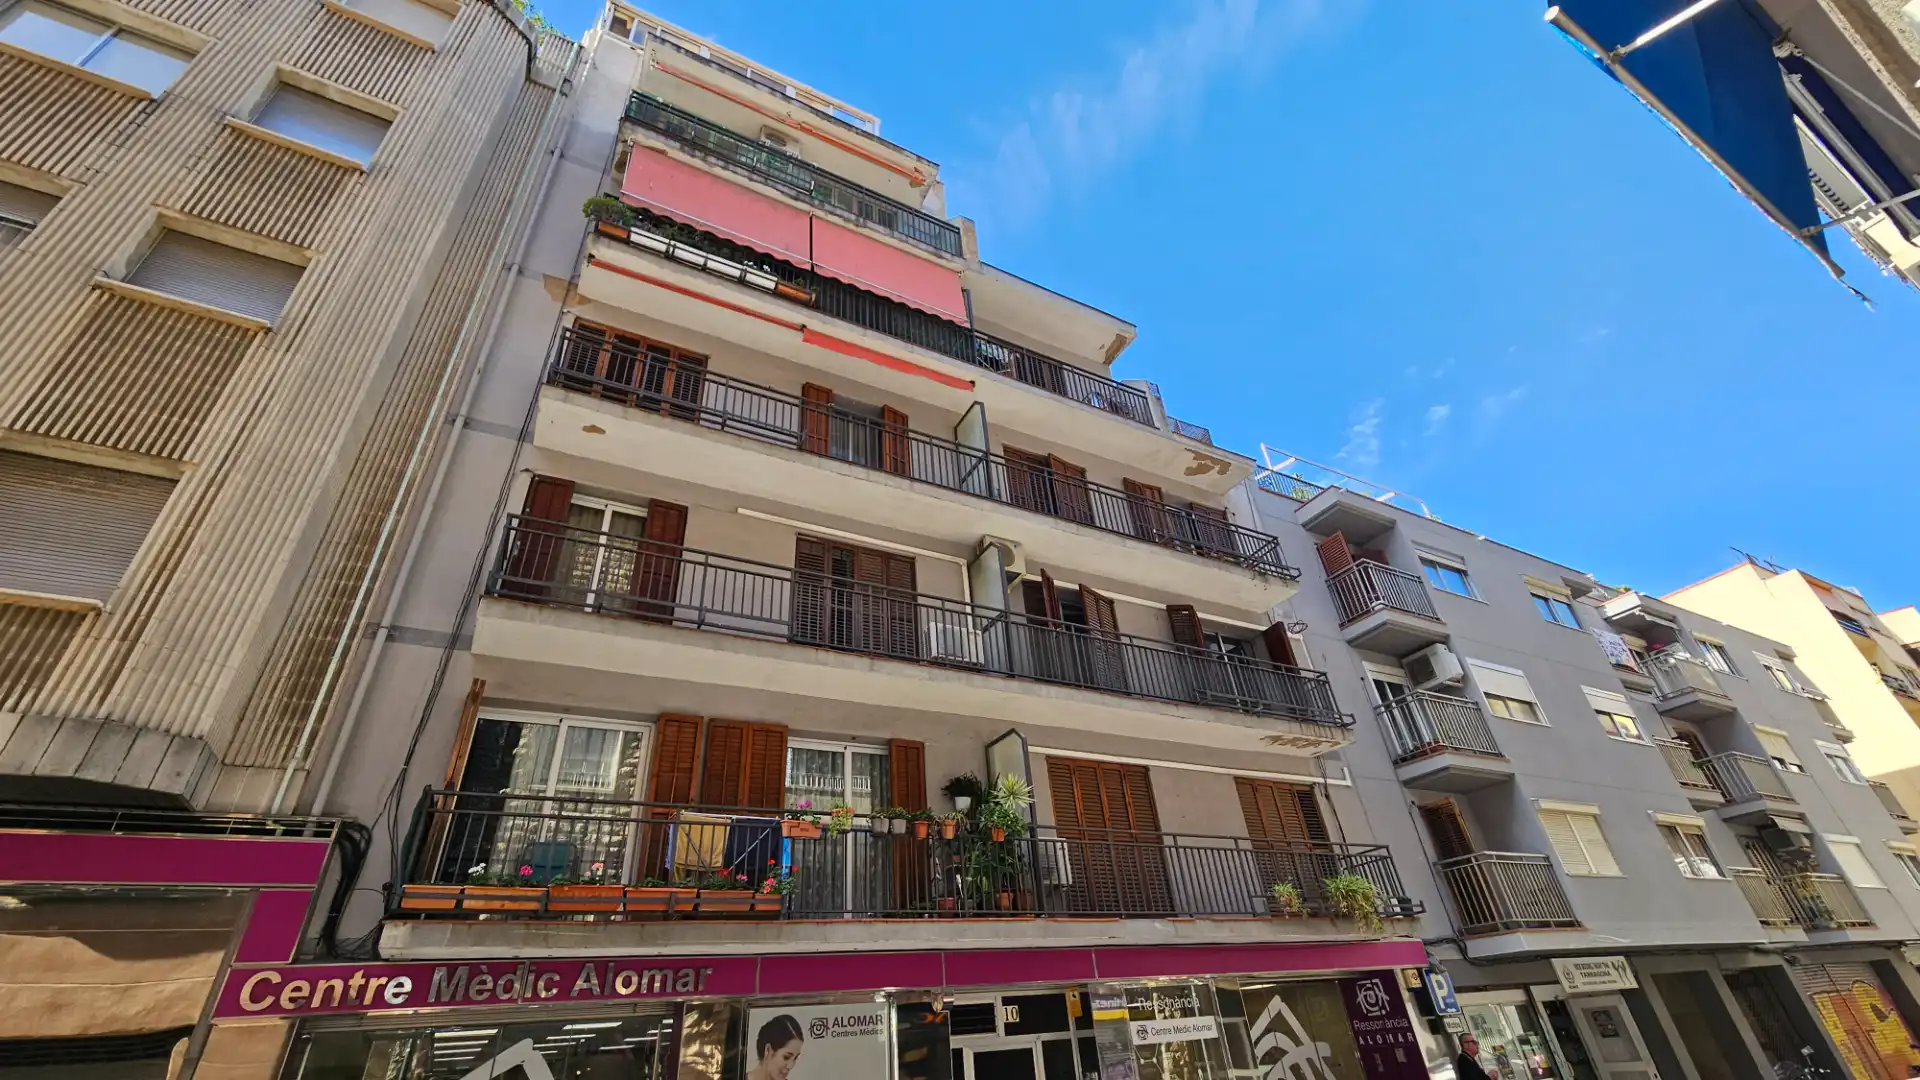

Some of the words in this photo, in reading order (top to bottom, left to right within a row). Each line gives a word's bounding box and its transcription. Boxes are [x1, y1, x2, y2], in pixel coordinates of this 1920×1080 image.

[239, 968, 413, 1012] Centre
[427, 964, 560, 1003] Mèdic
[570, 962, 713, 998] Alomar
[1430, 973, 1449, 1010] P
[832, 1014, 883, 1028] ALOMAR
[1004, 1007, 1018, 1021] 10
[1150, 1026, 1172, 1037] Centre
[1192, 1023, 1213, 1033] Alomar
[1353, 1017, 1409, 1031] Ressonància
[831, 1029, 858, 1038] Centres
[1359, 1032, 1415, 1045] ALOMAR
